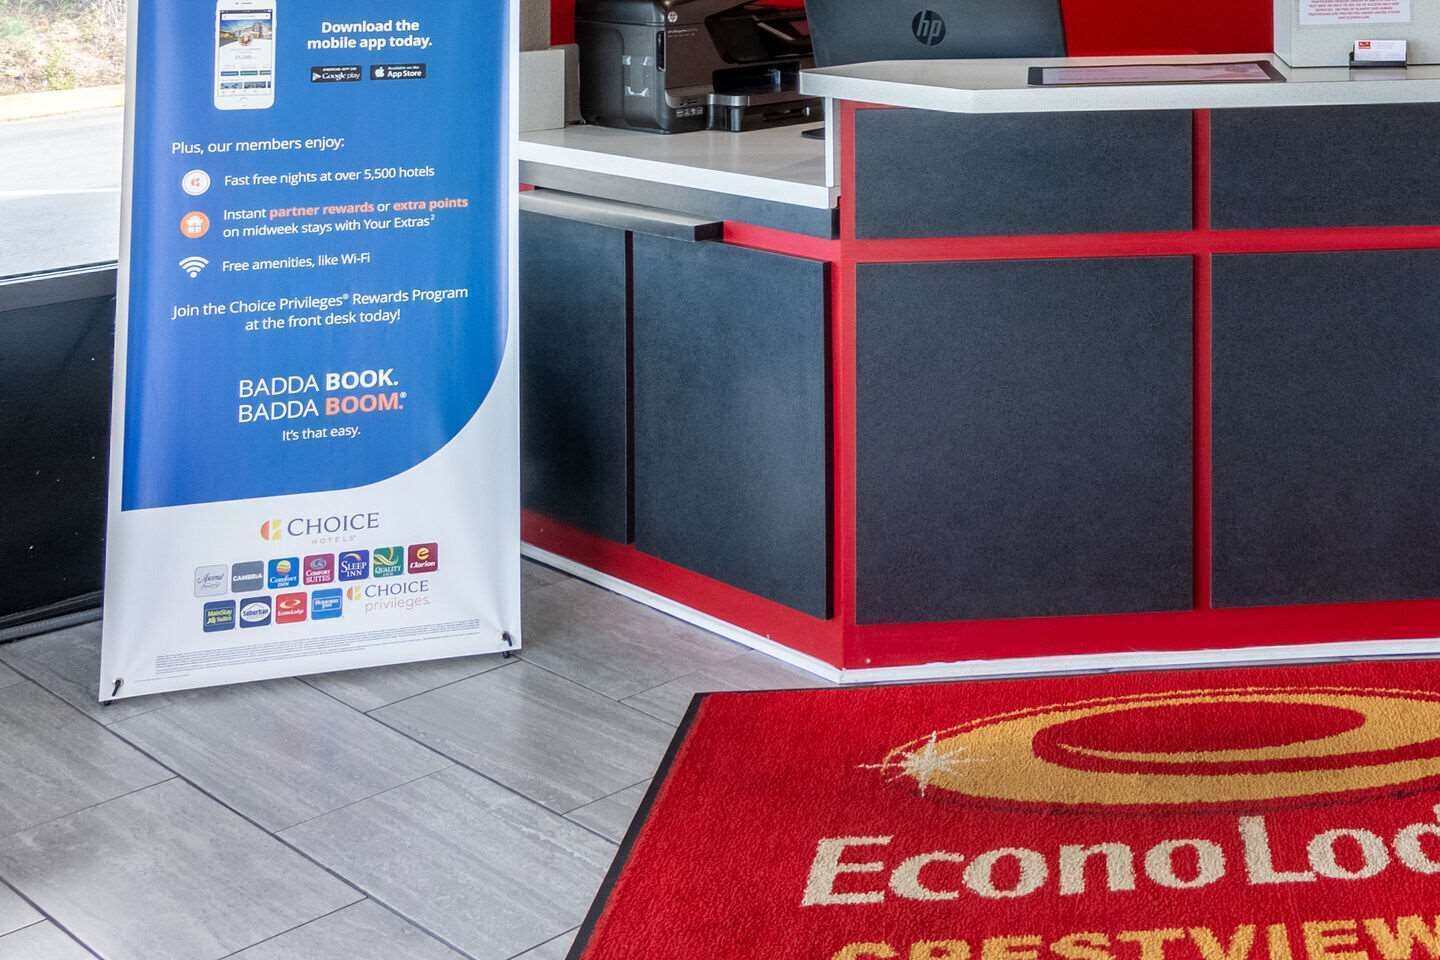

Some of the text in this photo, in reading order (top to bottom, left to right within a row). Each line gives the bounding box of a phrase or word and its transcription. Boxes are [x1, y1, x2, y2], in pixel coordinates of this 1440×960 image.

[321, 19, 419, 33] Download the
[916, 10, 942, 45] hp
[307, 35, 432, 51] mobile app today.
[322, 72, 346, 81] Google
[387, 70, 402, 78] App
[172, 136, 344, 155] Plus, our members enjoy:
[225, 165, 435, 186] Fast free nights at over 5,500 hotels
[224, 198, 469, 221] Instant partner rewards or extra points
[223, 229, 239, 237] on
[243, 223, 298, 236] midweek
[302, 224, 332, 235] stays
[335, 219, 360, 231] with
[363, 219, 391, 229] Your
[223, 252, 370, 272] Free amenities, like Wi-Fi
[171, 304, 199, 320] Join
[202, 303, 226, 315] the
[229, 300, 276, 313] Choice
[352, 290, 409, 304] Rewards
[412, 288, 468, 303] Program
[245, 309, 400, 331] at the front desk today!
[239, 368, 398, 398] BADDA BOOK.
[238, 399, 319, 423] BADDA
[283, 426, 360, 441] It's that easy.
[287, 512, 380, 537] CHOICE
[340, 560, 367, 573] SLEEP
[346, 569, 362, 577] INN
[374, 565, 401, 574] QUALITY
[409, 560, 436, 569] Clarion
[364, 579, 429, 598] CHOICE
[364, 596, 431, 614] privileges
